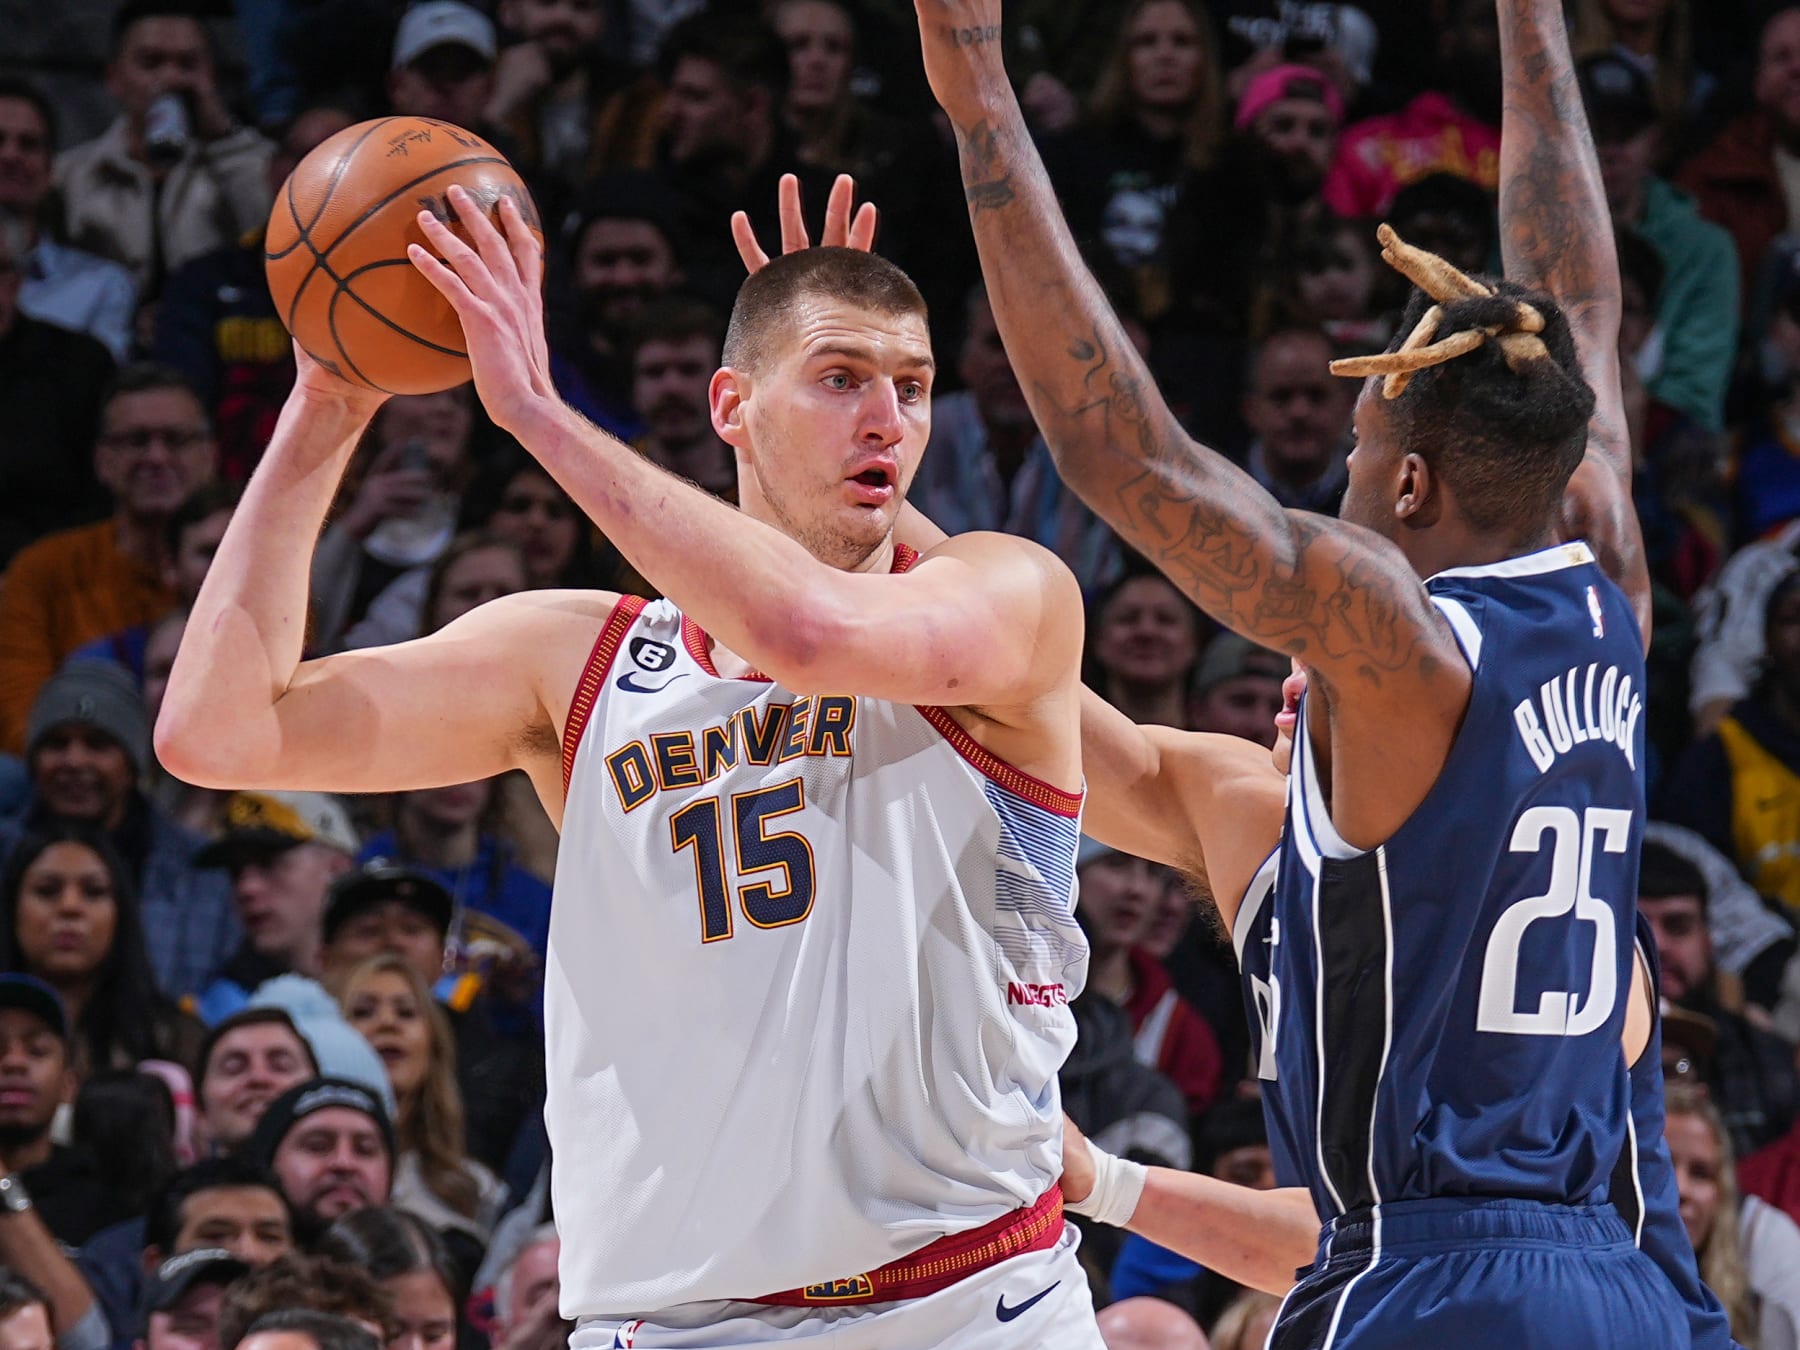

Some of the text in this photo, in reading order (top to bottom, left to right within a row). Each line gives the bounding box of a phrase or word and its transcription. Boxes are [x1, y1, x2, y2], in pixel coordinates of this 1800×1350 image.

[636, 643, 668, 669] 6
[604, 695, 856, 814] DENVER
[1513, 662, 1642, 774] BULLOCK
[669, 777, 816, 944] 15
[1476, 806, 1633, 1036] 25
